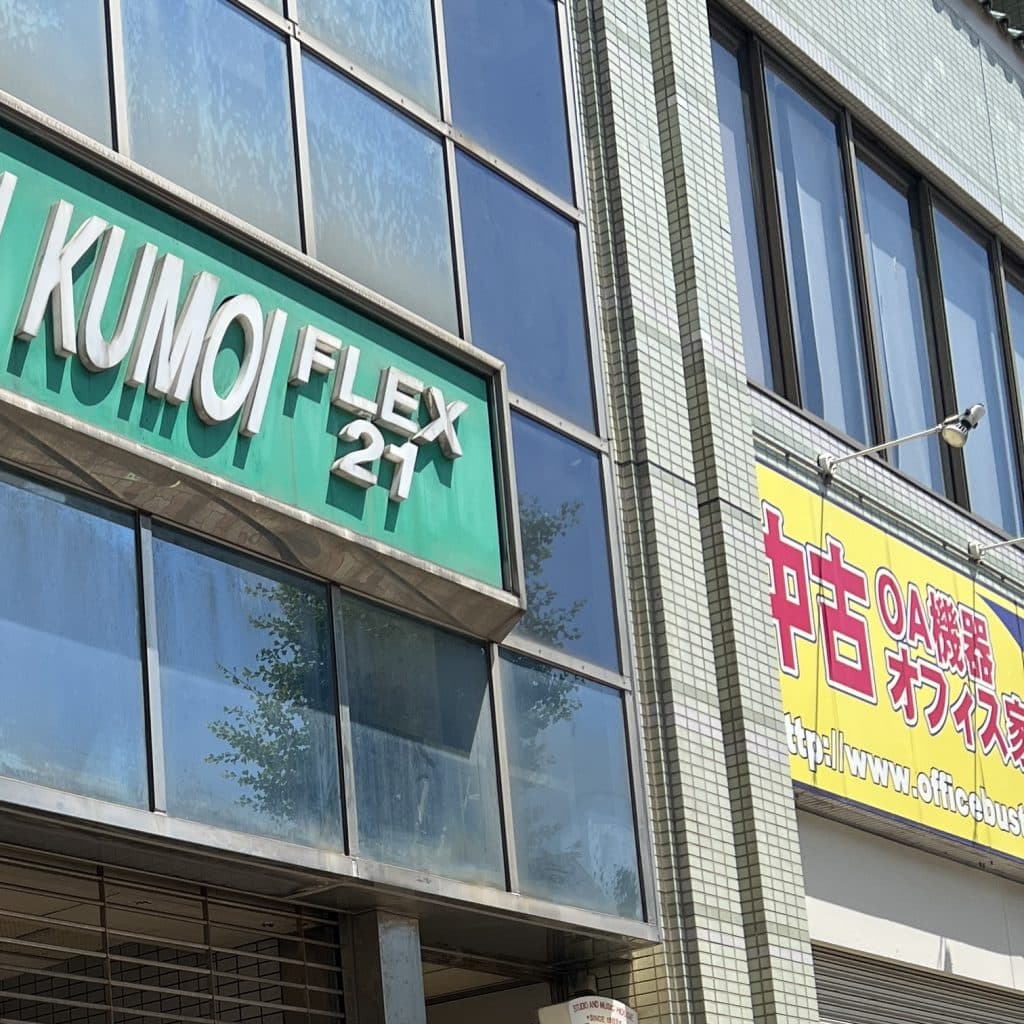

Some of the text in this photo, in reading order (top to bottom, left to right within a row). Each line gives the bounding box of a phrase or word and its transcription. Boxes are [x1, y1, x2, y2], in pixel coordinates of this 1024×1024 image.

[15, 199, 287, 438] KUMOI
[288, 325, 469, 459] FLEX
[330, 420, 420, 503] 21
[762, 499, 878, 706] 中古
[875, 566, 996, 691] OA機器
